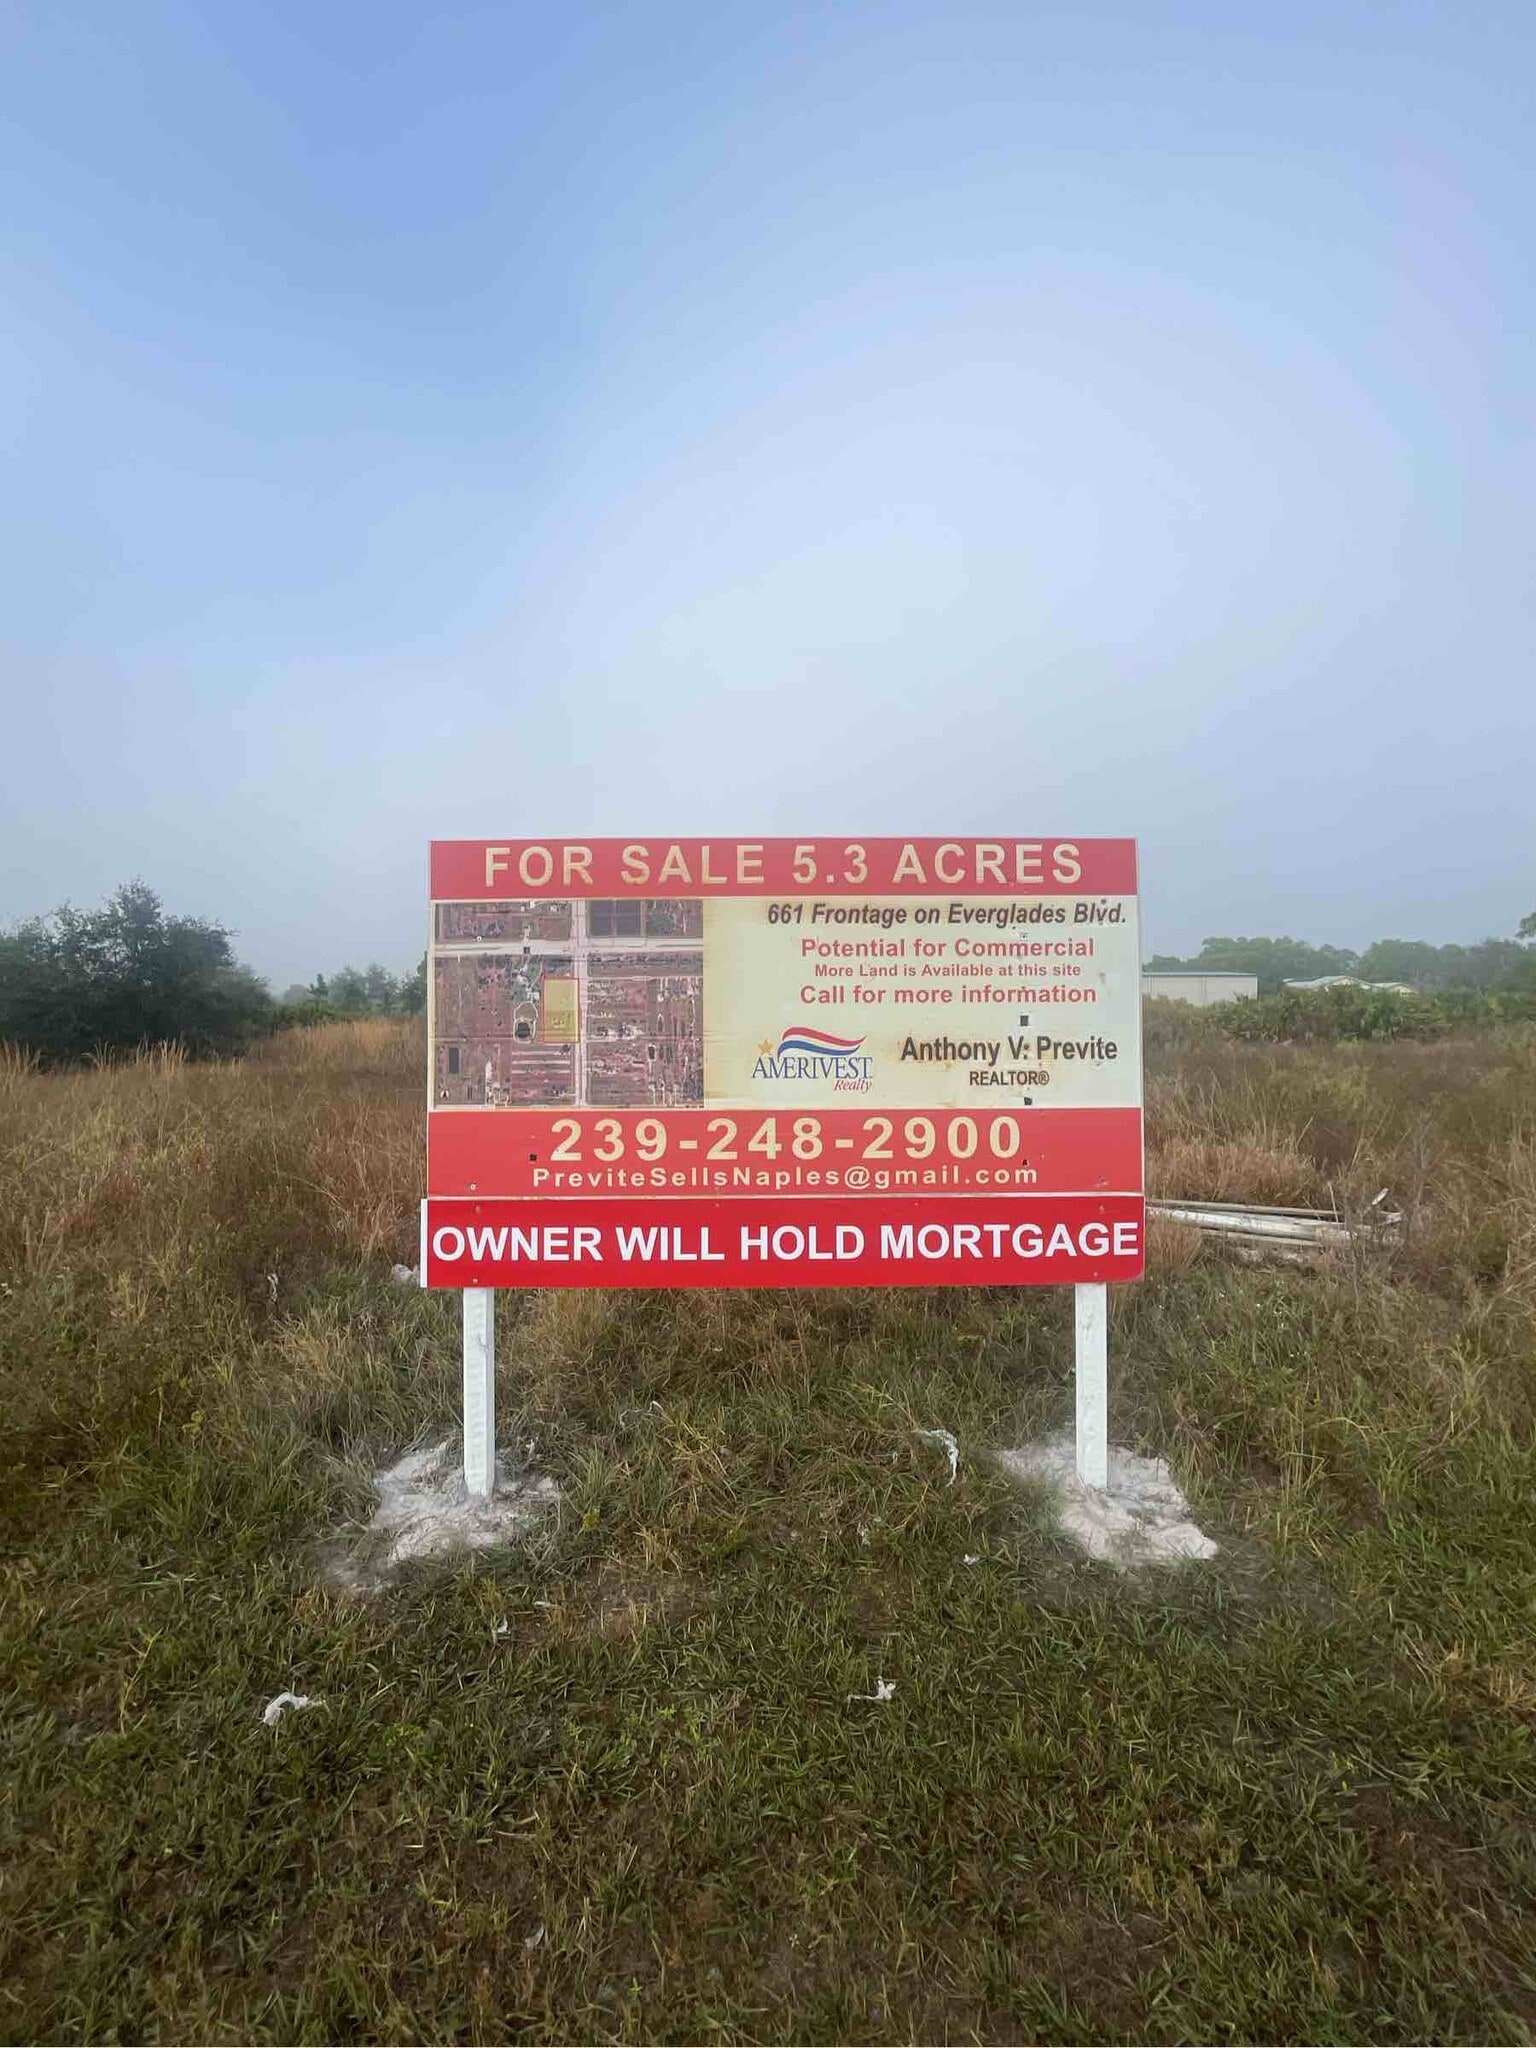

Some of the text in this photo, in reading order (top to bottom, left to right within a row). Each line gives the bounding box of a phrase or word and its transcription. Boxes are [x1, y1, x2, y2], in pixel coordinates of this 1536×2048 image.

[484, 844, 1083, 886] FOR SALE 5.3 ACRES
[768, 903, 1127, 929] 661 Frontage on Everglades Blvd.
[802, 939, 1094, 957] Potential for Commercial
[815, 963, 1081, 977] More Land is Available at this site
[801, 985, 1097, 1004] Call for more information
[901, 1037, 1000, 1066] Anthony
[1037, 1036, 1118, 1060] Previte
[752, 1057, 873, 1079] AMERIVEST
[834, 1078, 872, 1093] Realty
[550, 1116, 1022, 1161] 239-248-2900
[532, 1165, 1039, 1189] PreviteSellsNaples@gmail.com
[432, 1222, 1138, 1261] OWNER WILL HOLD MORTGAGE
